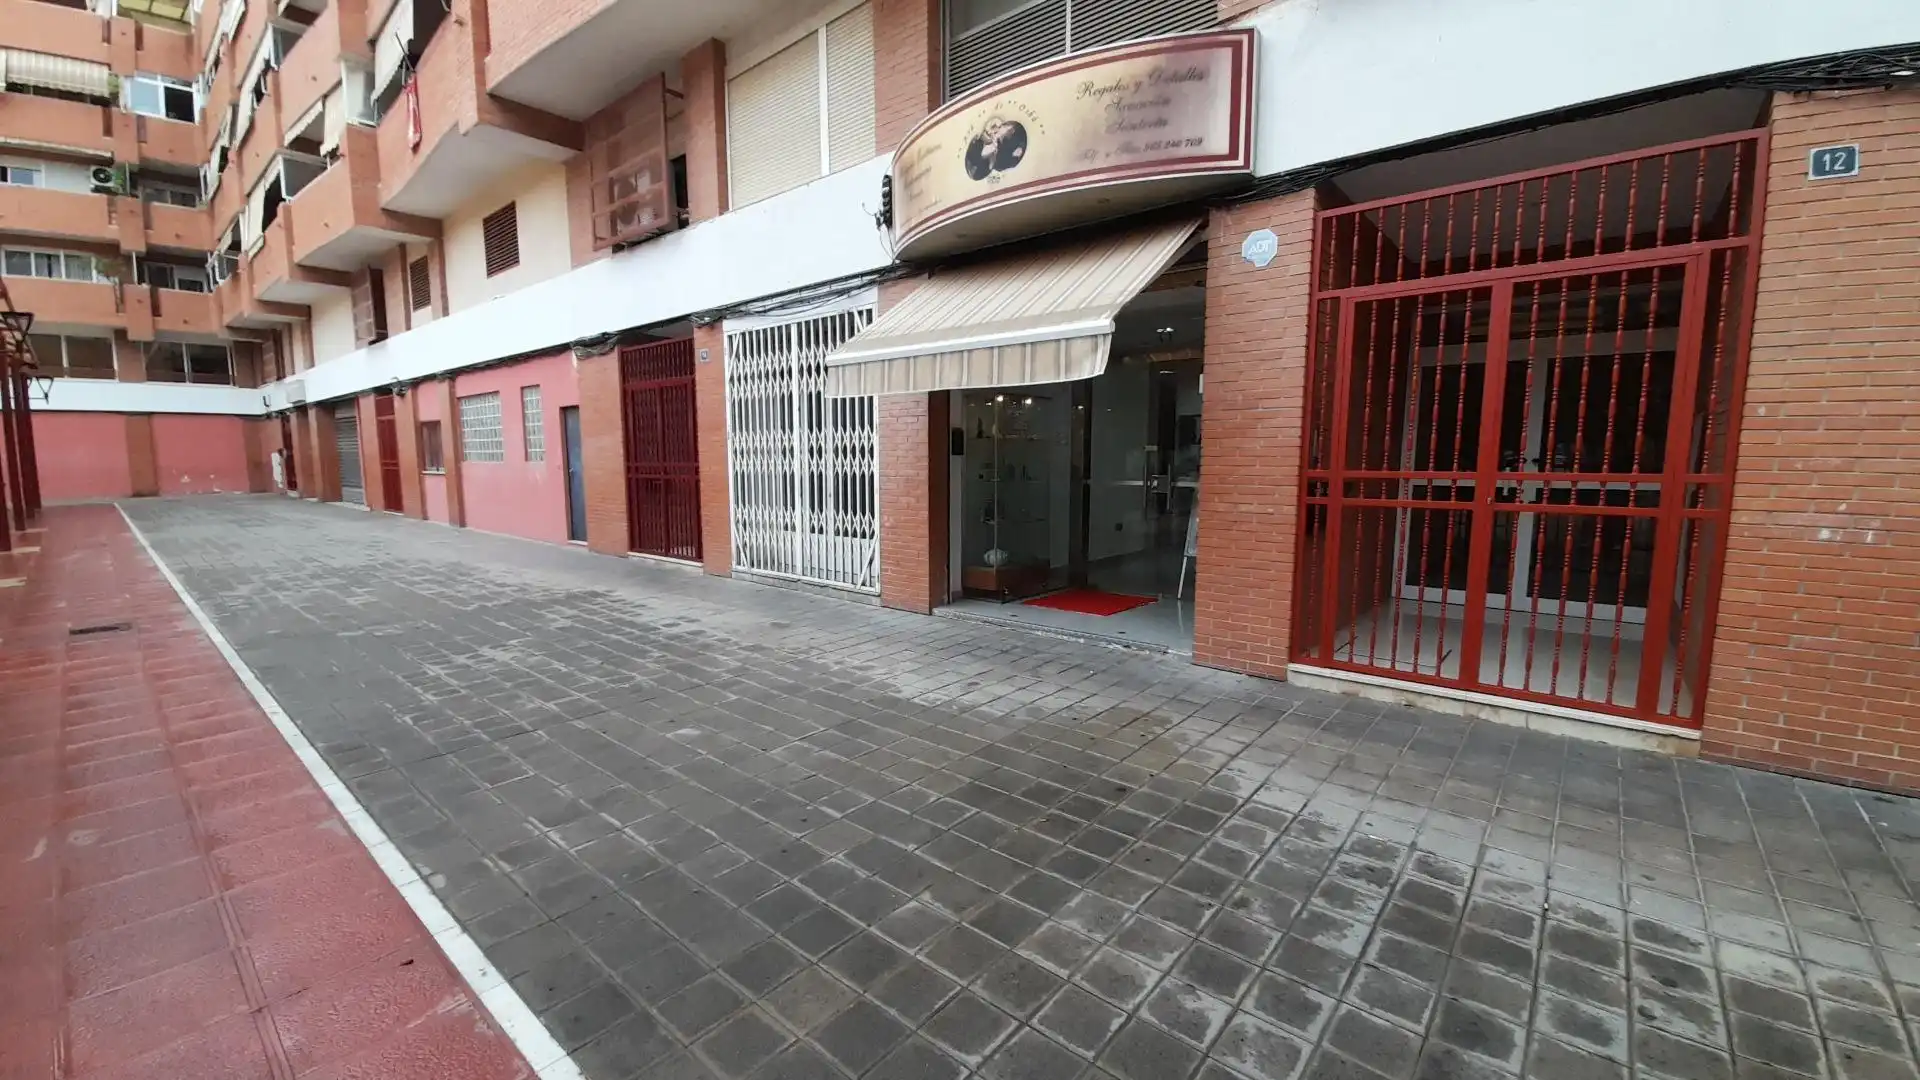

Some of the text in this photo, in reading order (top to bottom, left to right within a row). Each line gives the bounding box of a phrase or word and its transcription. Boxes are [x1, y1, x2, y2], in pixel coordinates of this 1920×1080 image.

[1077, 77, 1129, 101] Regalos
[1132, 79, 1142, 93] y
[1823, 151, 1847, 171] 12
[1250, 239, 1273, 254] ADT
